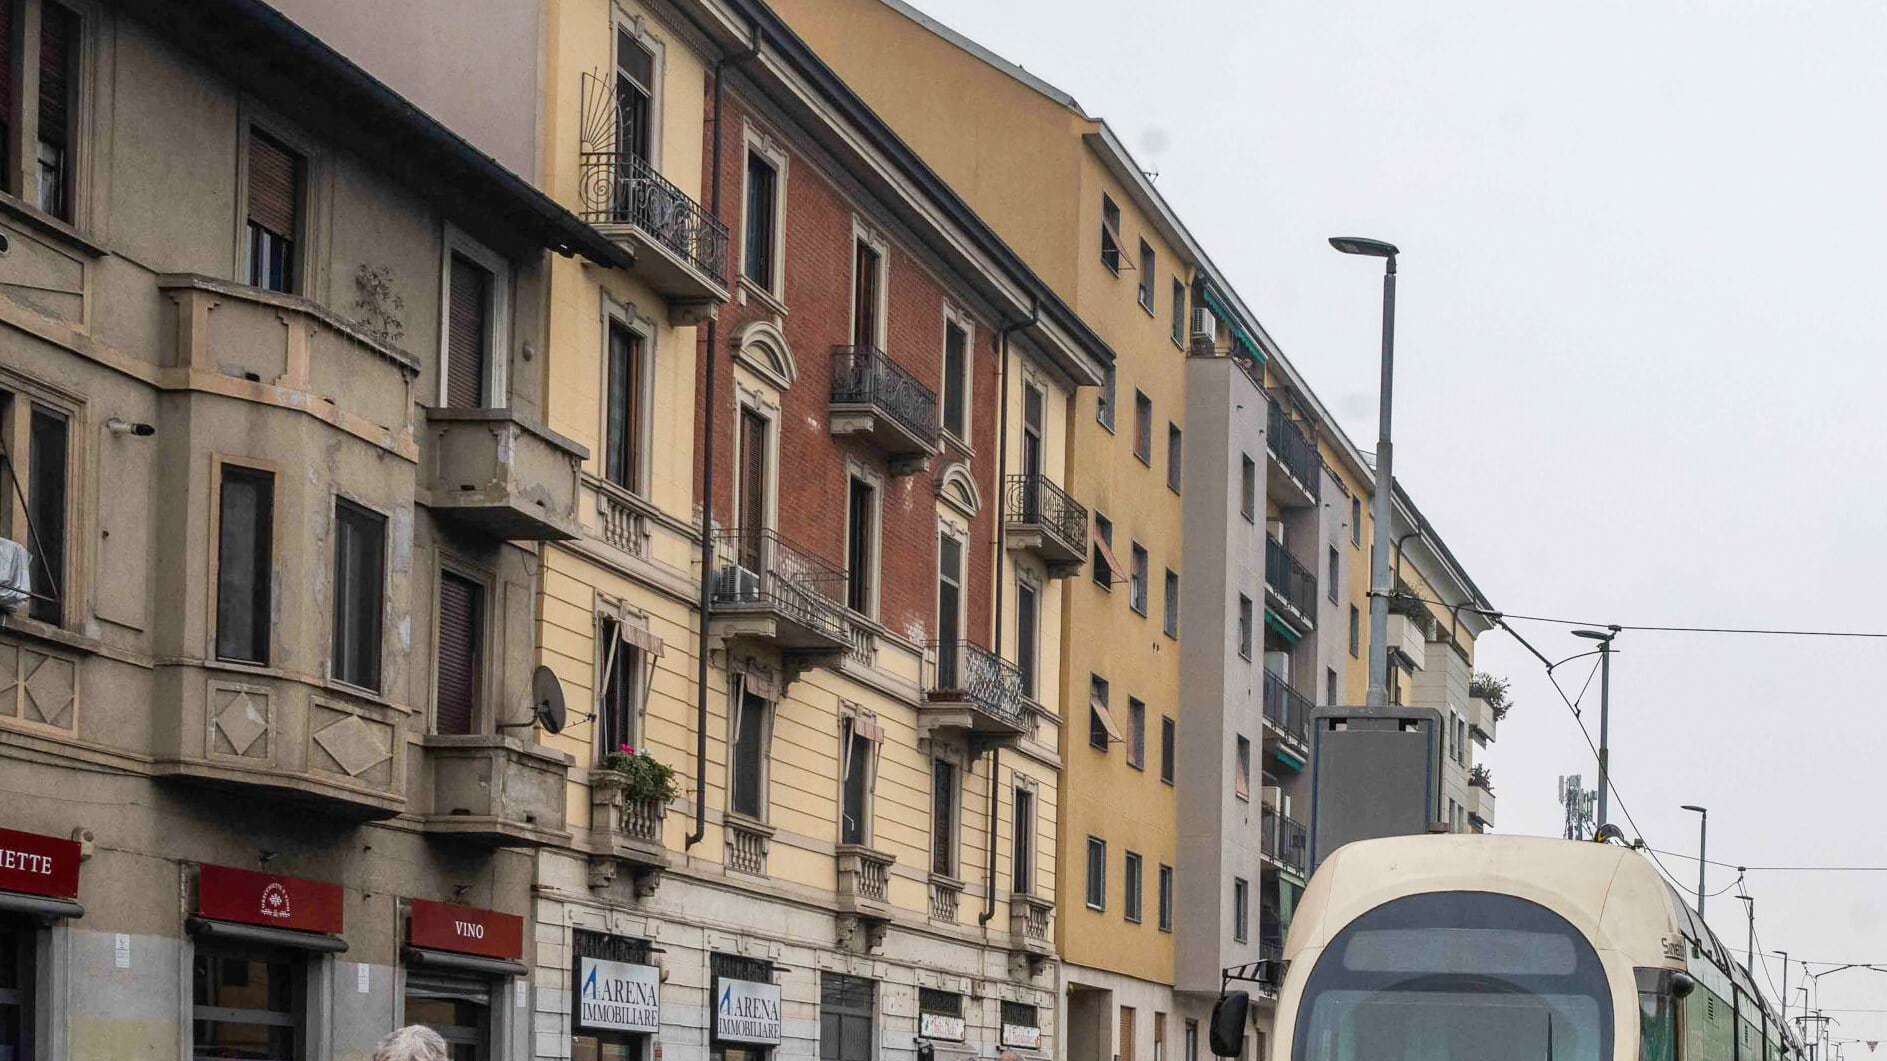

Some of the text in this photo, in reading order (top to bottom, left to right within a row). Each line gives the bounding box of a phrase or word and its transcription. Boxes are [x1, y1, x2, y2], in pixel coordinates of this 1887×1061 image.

[455, 920, 484, 939] VINO
[602, 978, 657, 1007] ARENA
[583, 1003, 657, 1027] IMMOBILIARE
[734, 996, 779, 1021] ARENA
[719, 1017, 779, 1039] IMMOBILIARE
